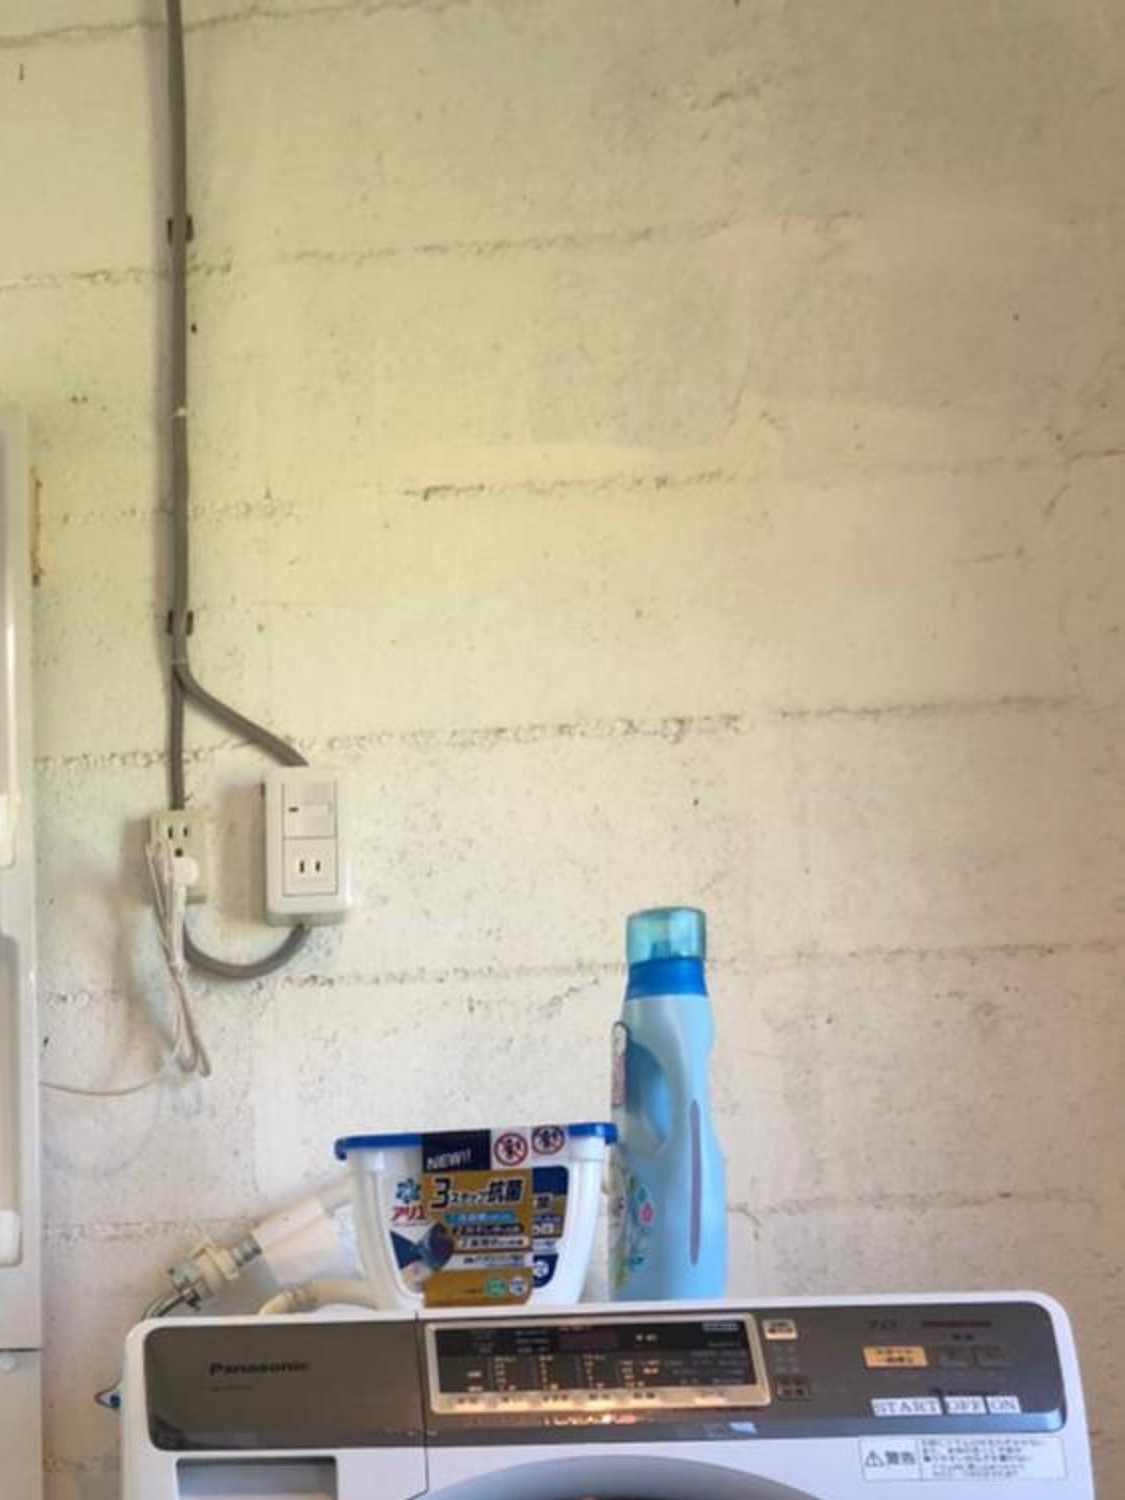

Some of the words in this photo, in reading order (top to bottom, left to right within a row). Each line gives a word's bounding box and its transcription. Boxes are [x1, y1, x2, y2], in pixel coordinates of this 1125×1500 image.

[209, 1360, 310, 1375] Panasonic
[876, 1399, 938, 1416] START
[990, 1396, 1016, 1412] ON
